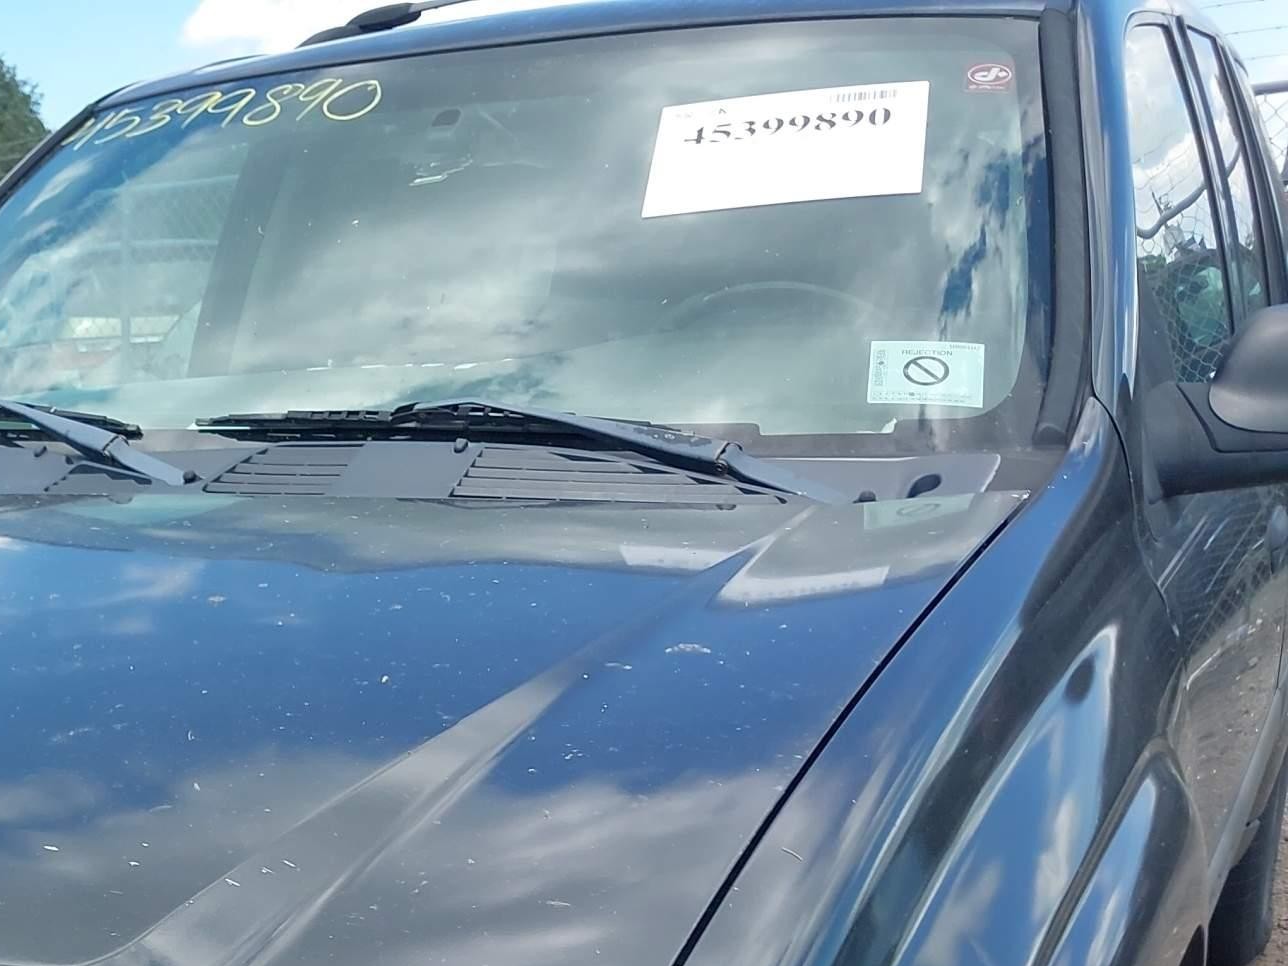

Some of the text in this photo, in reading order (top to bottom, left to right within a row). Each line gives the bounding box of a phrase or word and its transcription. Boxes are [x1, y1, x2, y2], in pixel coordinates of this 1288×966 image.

[63, 78, 381, 151] 45399890
[683, 106, 892, 145] 45399890
[902, 349, 953, 357] REJECTION
